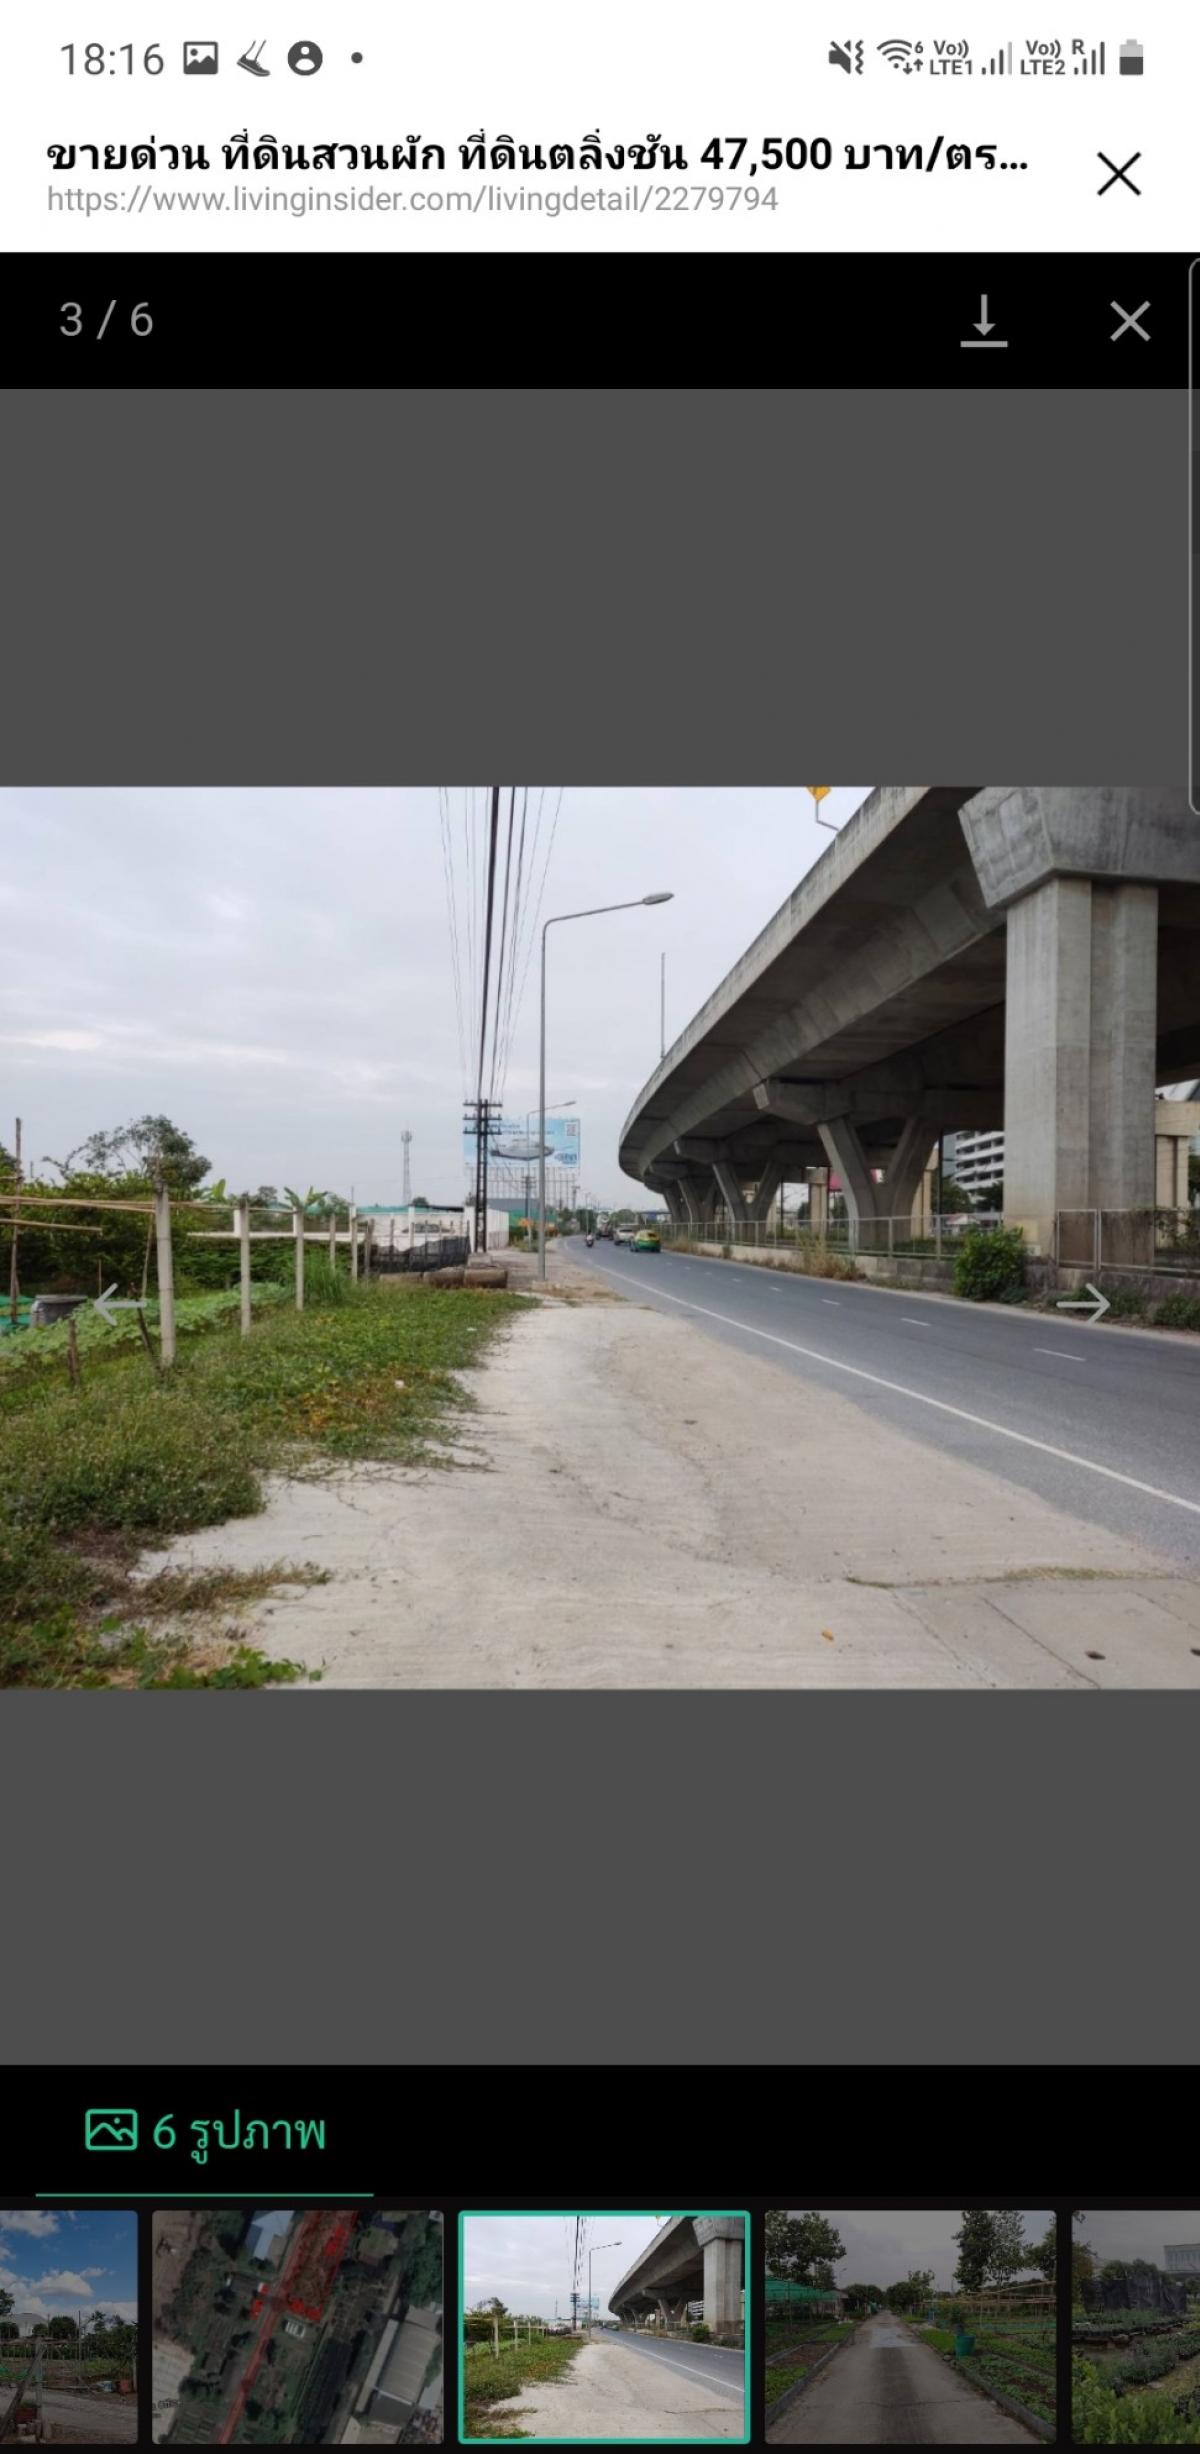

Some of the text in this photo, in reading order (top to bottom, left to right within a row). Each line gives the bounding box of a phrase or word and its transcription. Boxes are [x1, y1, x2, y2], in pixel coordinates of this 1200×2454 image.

[60, 42, 165, 76] 18:16
[1071, 39, 1086, 56] R
[929, 58, 973, 76] LTE1
[1020, 58, 1066, 76] LTE2
[46, 134, 211, 171] ขายด่วน
[220, 127, 446, 171] ที่ดินสวนผัก
[457, 127, 689, 171] ที่ดินตลิ่งชัน
[699, 136, 833, 178] 47,500
[47, 184, 780, 218] https://www.livinginsider.com/livingdetail/2279794
[59, 299, 153, 340] 3 / 6
[153, 2108, 325, 2165] 6 รูปภาพ
